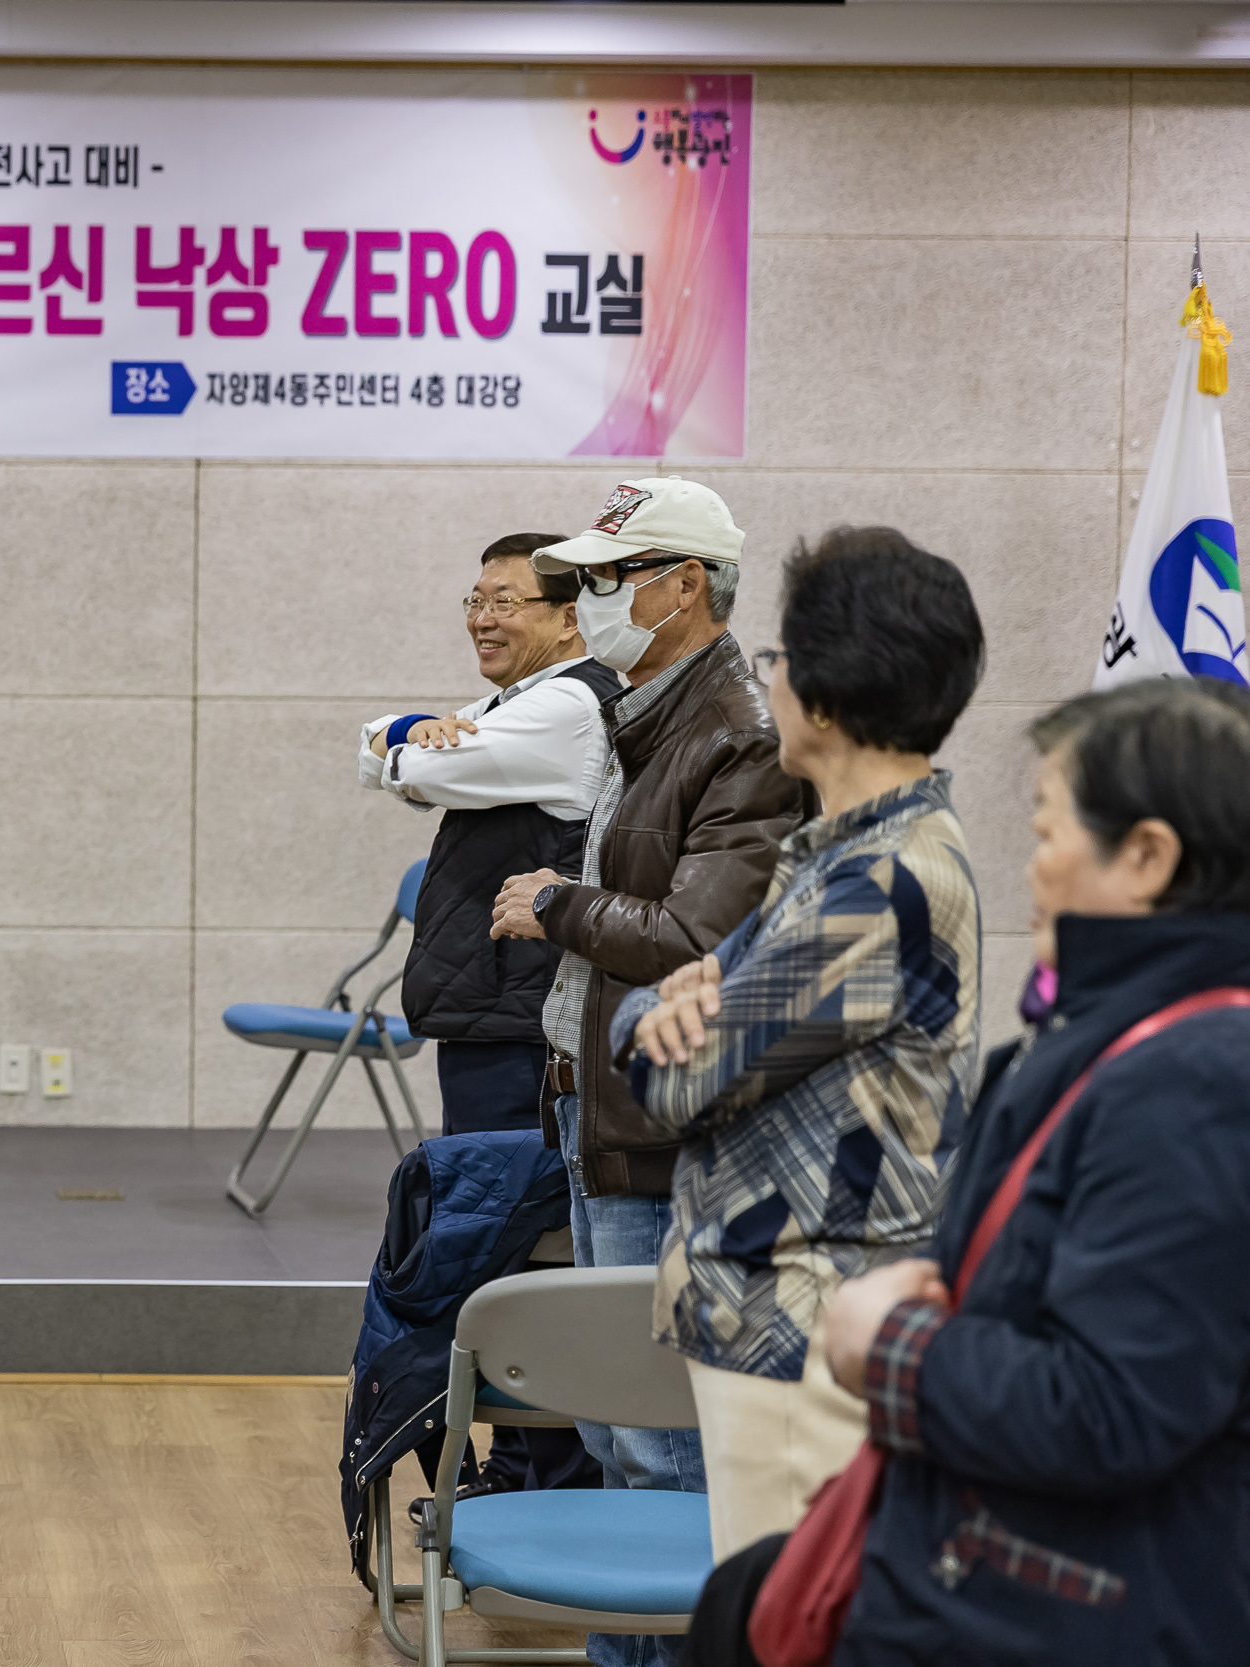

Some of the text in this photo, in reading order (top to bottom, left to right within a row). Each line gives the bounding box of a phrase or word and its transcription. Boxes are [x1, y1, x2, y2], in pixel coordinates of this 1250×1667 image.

[85, 146, 138, 188] 대비
[136, 227, 279, 337] 낙상
[301, 230, 515, 339] ZERO
[541, 253, 645, 337] 교실
[126, 368, 169, 402] 장소
[207, 373, 521, 407] 자양제4동주민센터 4층 대강당
